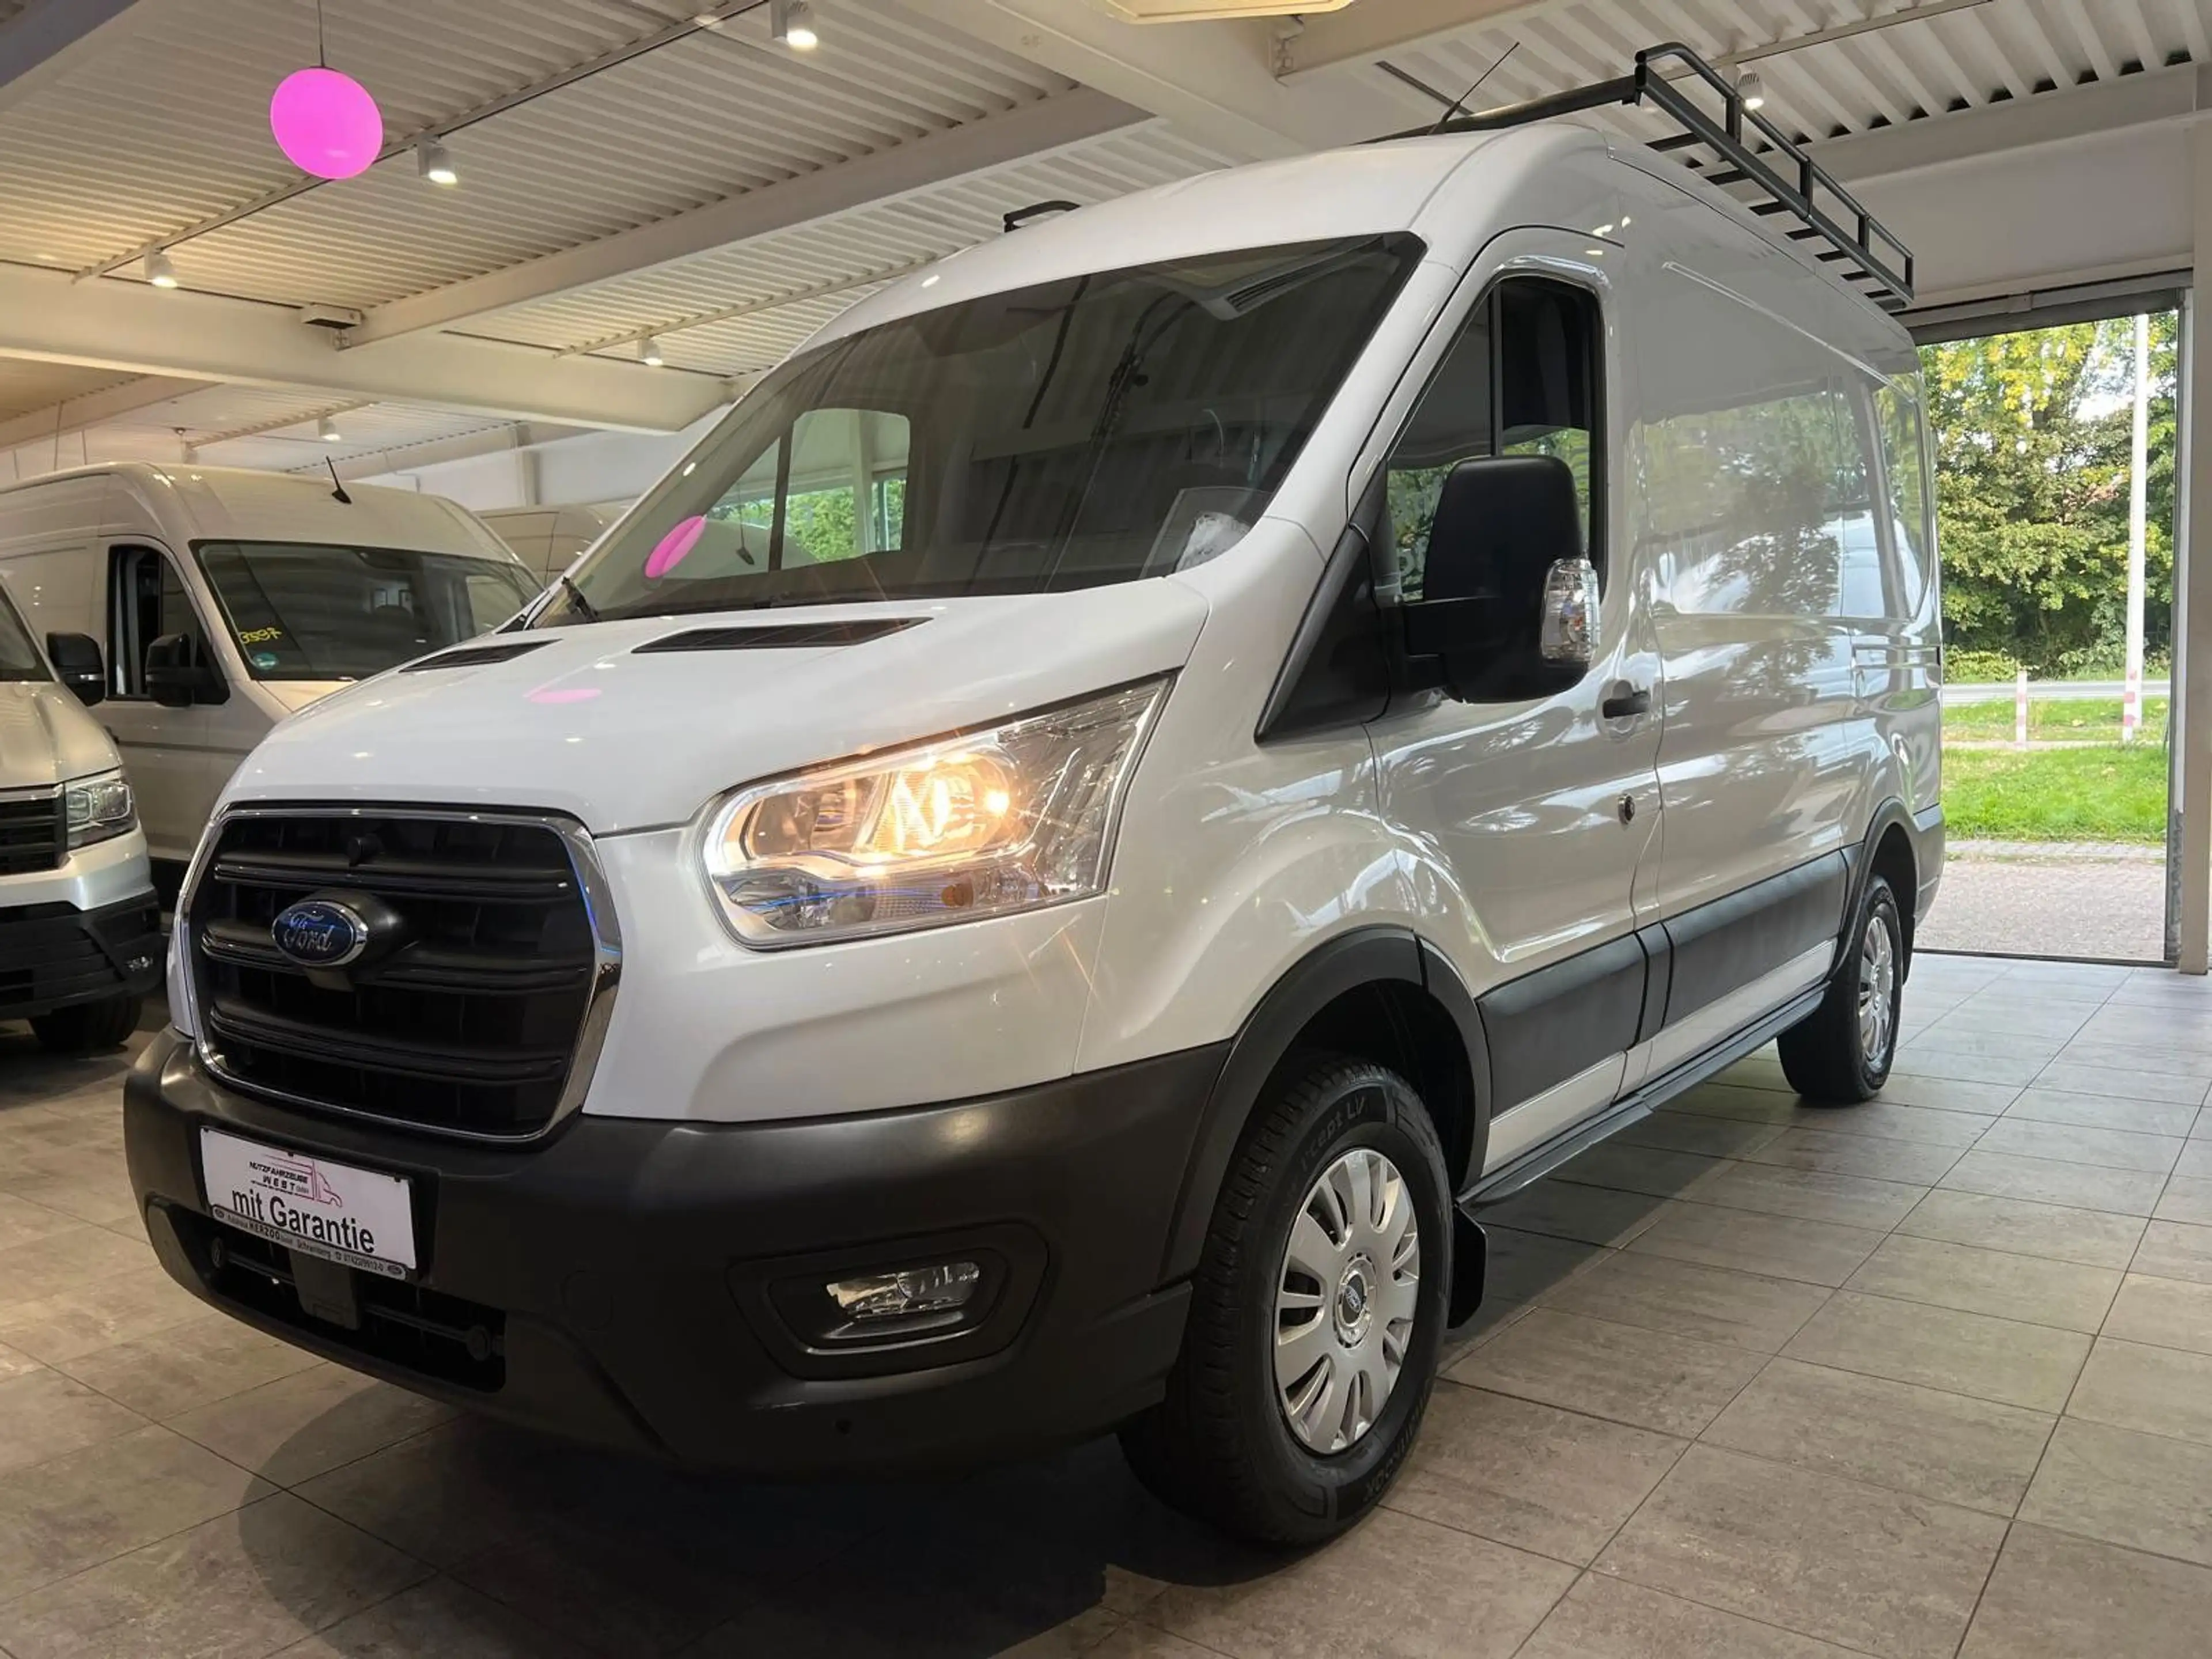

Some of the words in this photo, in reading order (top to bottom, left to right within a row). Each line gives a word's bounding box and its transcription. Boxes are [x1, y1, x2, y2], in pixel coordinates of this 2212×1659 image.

[283, 911, 332, 952] Ford
[263, 1175, 296, 1191] WEST
[232, 1189, 265, 1222] mit
[270, 1196, 374, 1253] Garantie
